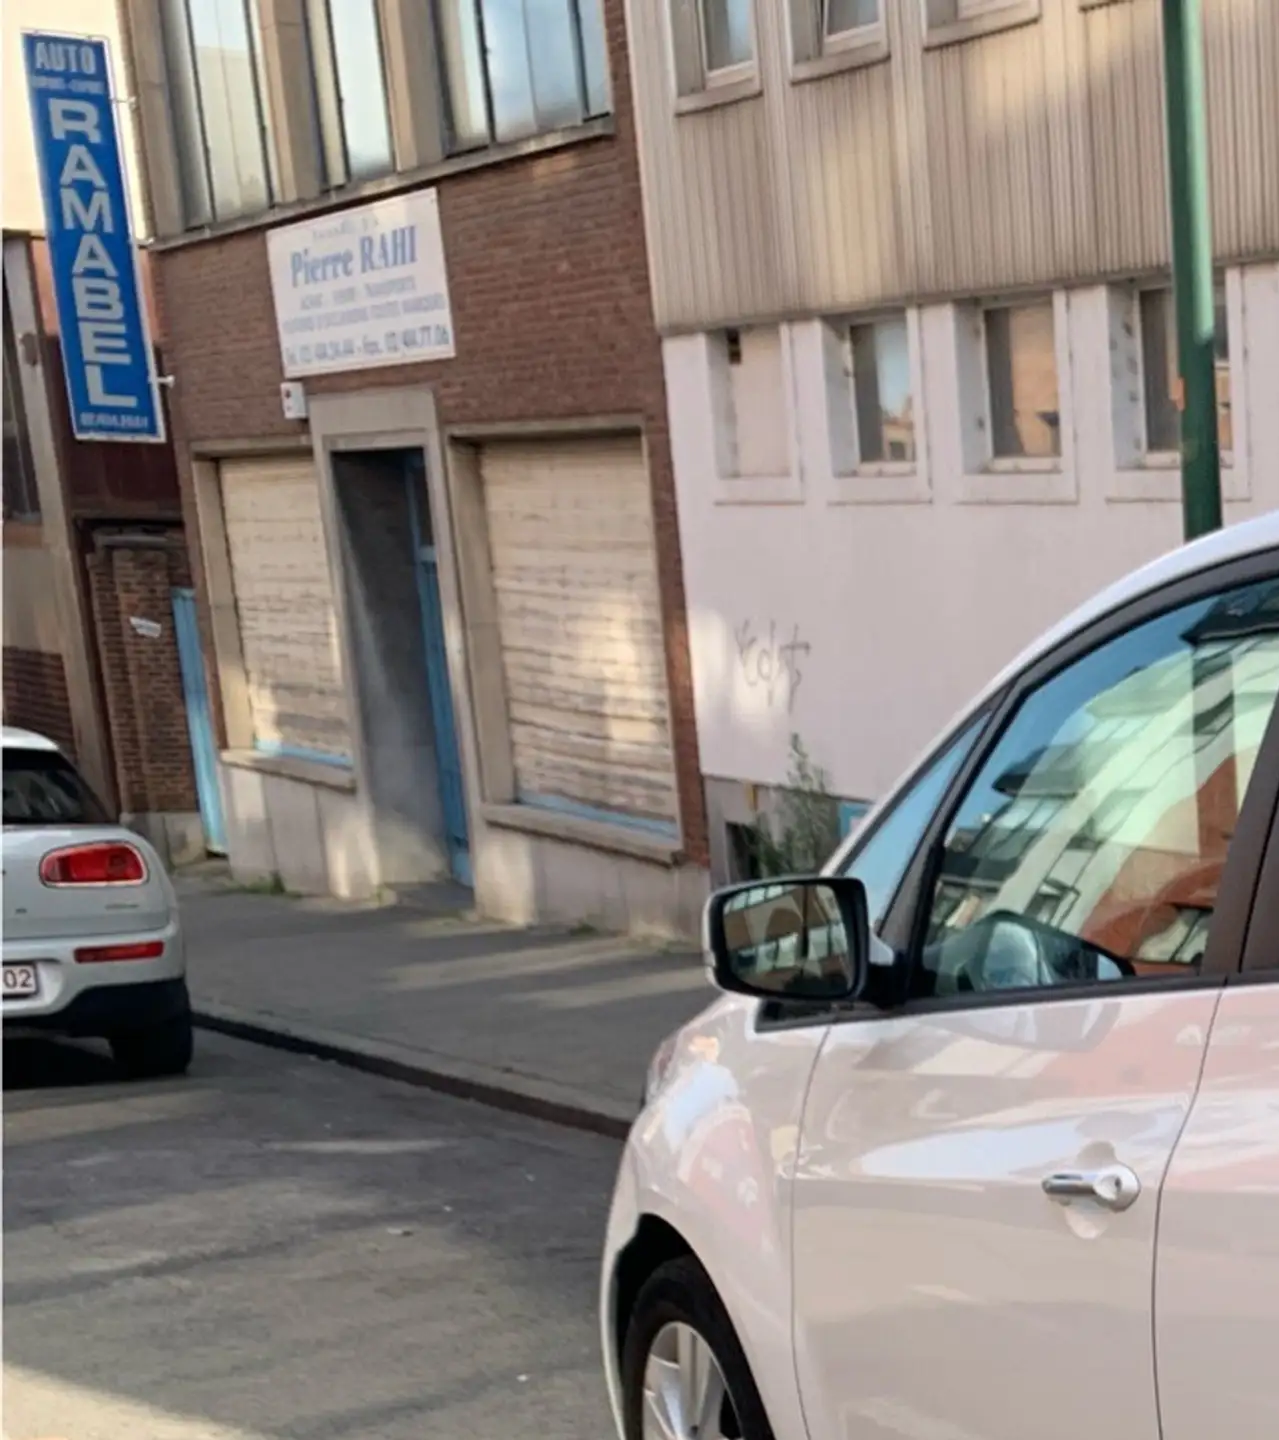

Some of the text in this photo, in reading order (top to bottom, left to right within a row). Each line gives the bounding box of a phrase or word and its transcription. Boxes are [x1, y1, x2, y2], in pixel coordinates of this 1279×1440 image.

[35, 42, 96, 74] AUTO
[48, 97, 138, 408] RAMABEL
[290, 247, 354, 289] Pierre
[358, 224, 418, 274] RAHI
